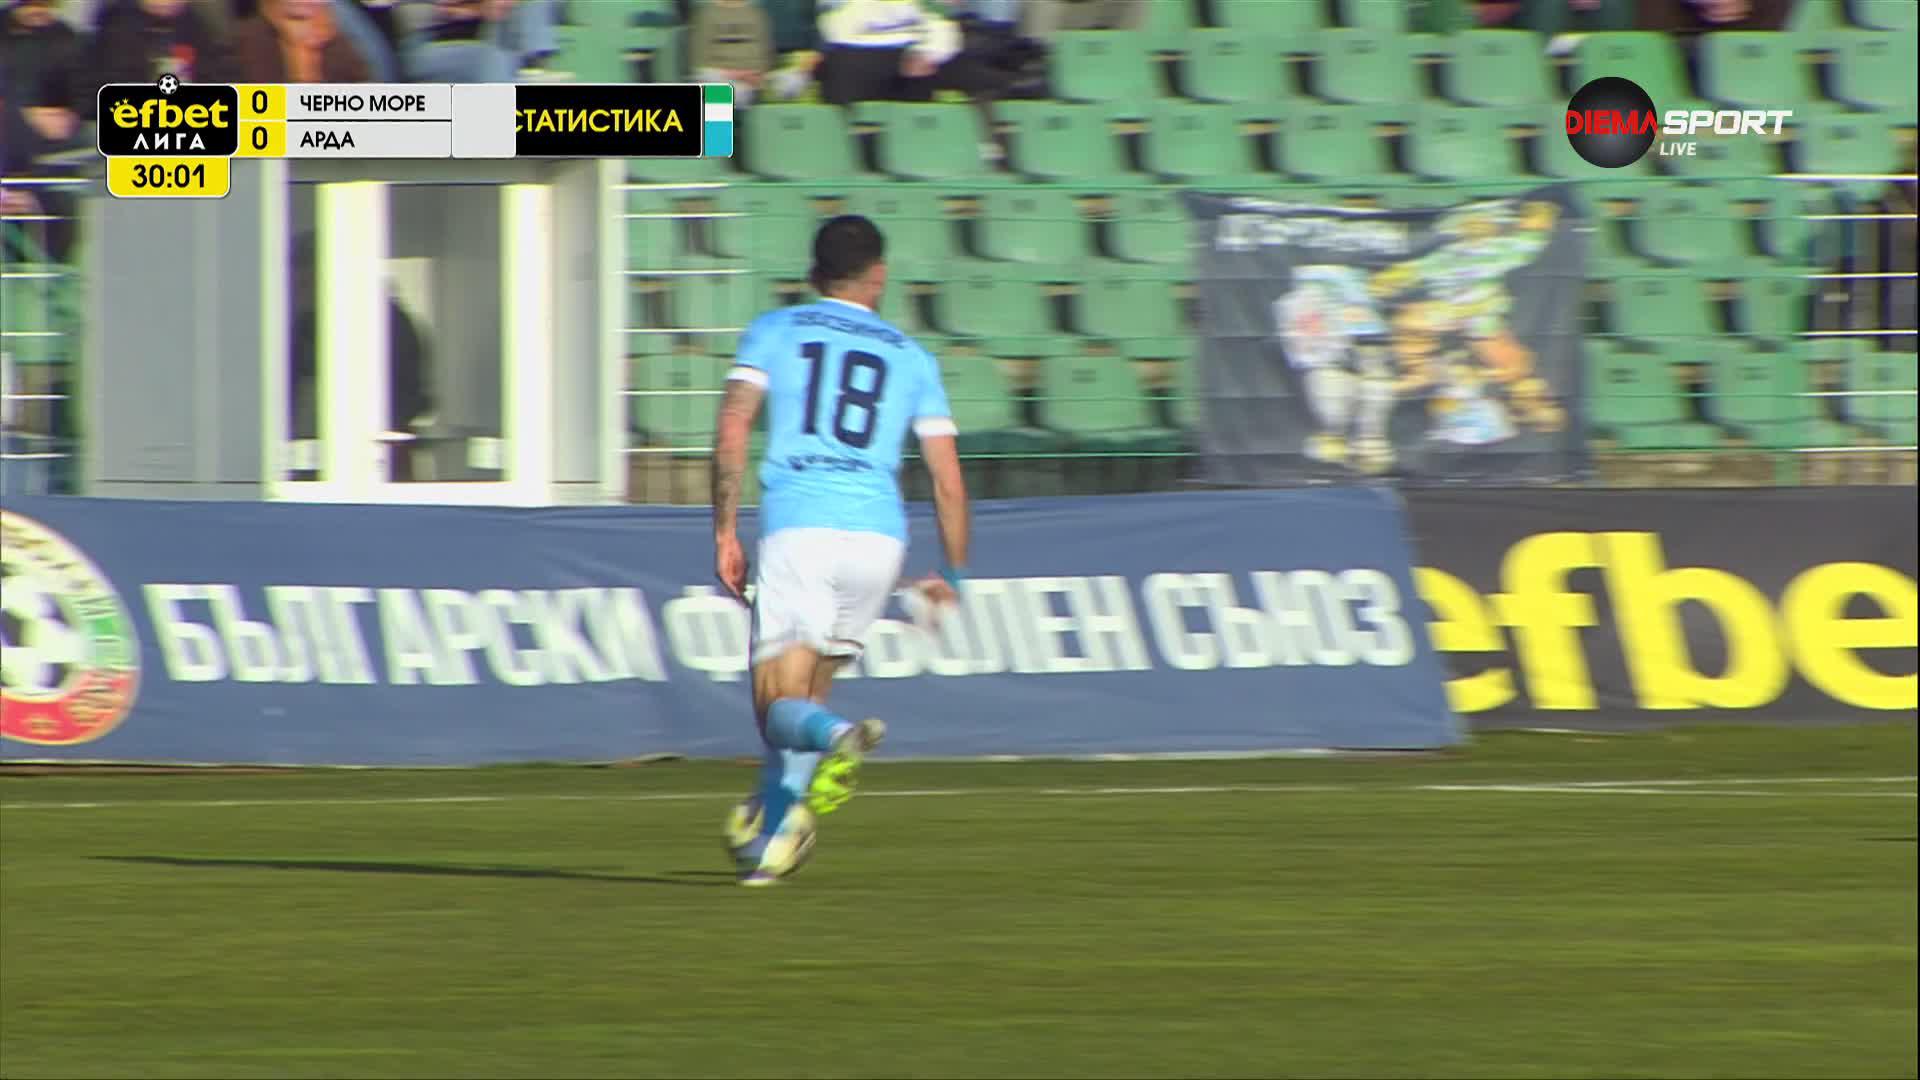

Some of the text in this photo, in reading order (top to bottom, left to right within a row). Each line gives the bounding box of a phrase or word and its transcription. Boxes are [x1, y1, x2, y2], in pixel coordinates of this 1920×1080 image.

[799, 341, 888, 449] 18
[143, 583, 668, 685] БЪЛГАРСКИ
[661, 575, 1153, 681] ФБОЛЕН
[1143, 569, 1416, 668] СЪЮЗ
